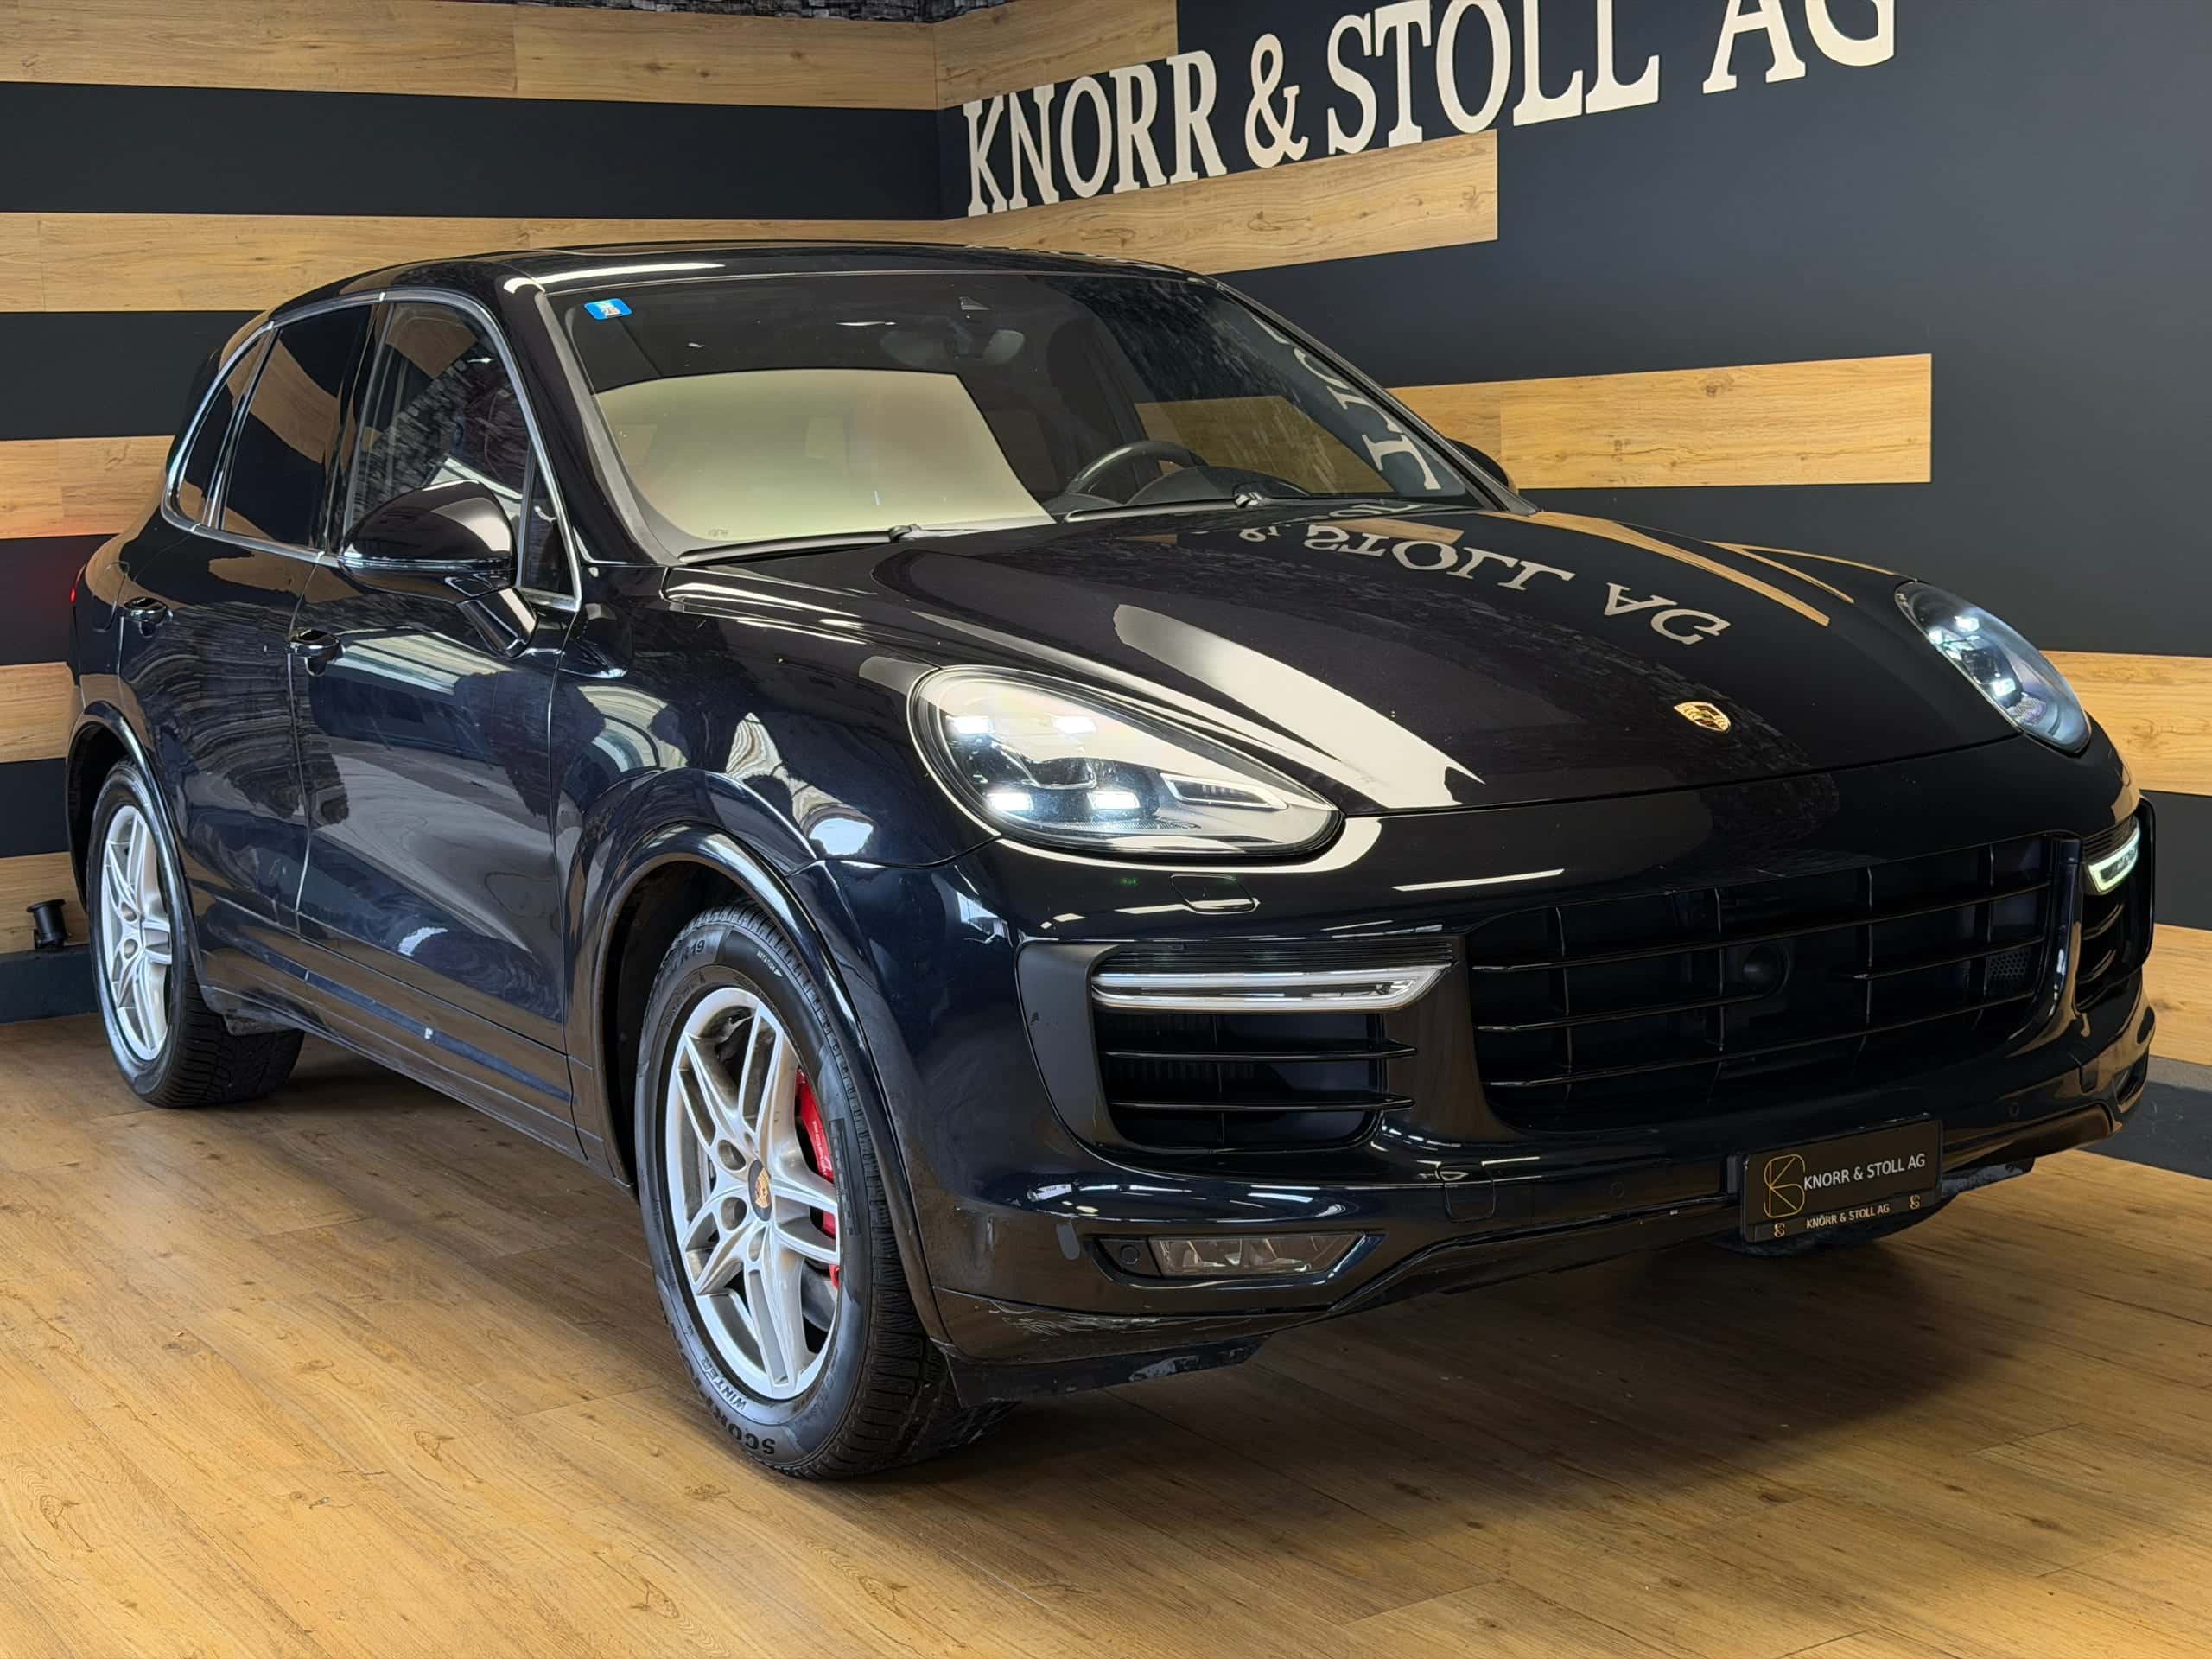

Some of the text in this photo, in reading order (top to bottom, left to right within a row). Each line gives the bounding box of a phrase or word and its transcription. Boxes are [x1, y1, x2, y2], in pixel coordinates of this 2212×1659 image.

[963, 50, 1227, 217] KNORR
[1244, 33, 1309, 168] &
[1327, 0, 1660, 154] STOLL
[1803, 1154, 1926, 1191] KNORR & STOLL AG
[700, 1356, 747, 1411] WINTER
